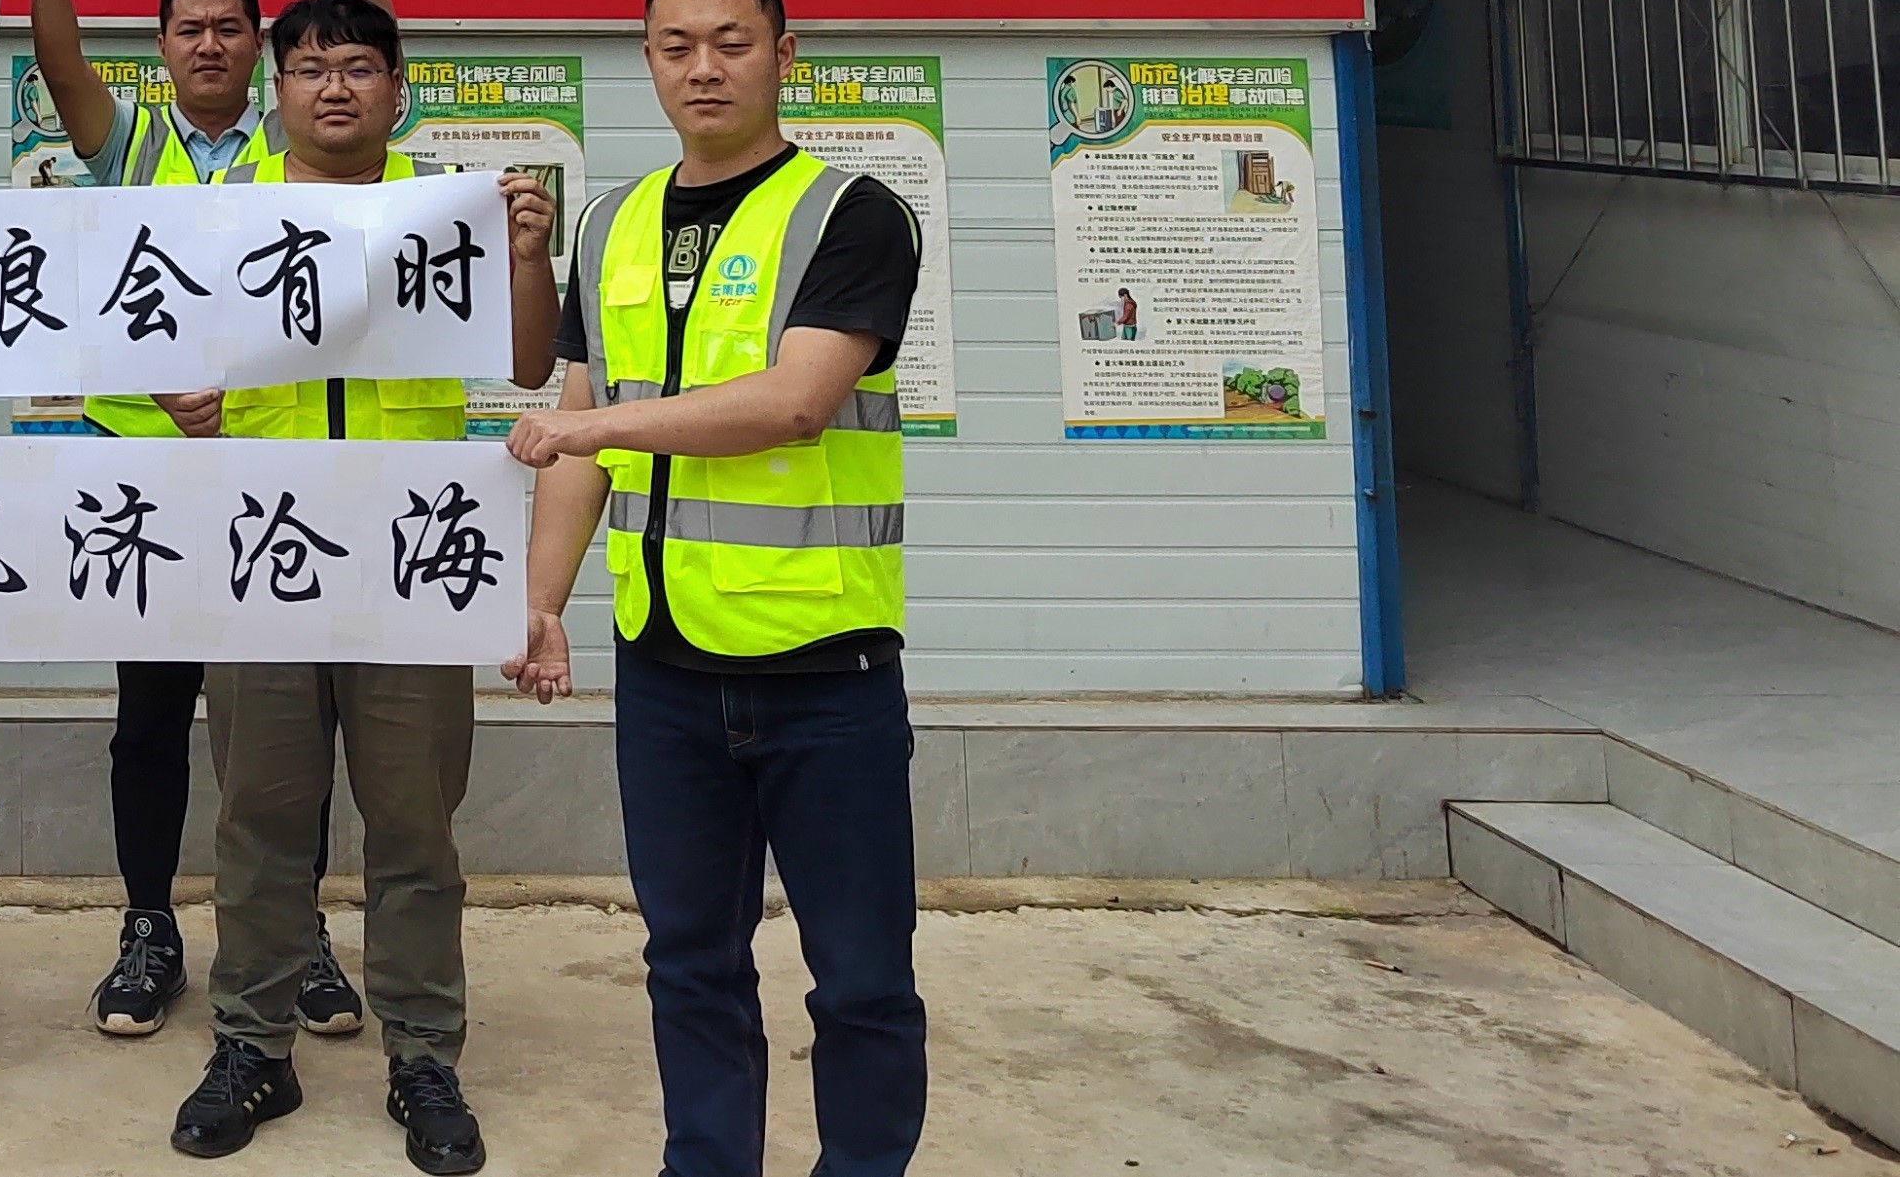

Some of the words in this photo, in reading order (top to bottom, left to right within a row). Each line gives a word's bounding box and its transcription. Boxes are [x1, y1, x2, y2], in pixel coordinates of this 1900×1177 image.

[407, 63, 566, 84] 防范化解安全风险
[1129, 62, 1292, 85] 防范化解安全风险
[419, 82, 578, 104] 排查治理事故隐患
[1141, 84, 1305, 106] 排查治理事故隐患
[431, 131, 541, 141] 安全风险分级与管控措施
[794, 131, 895, 140] 安全生产事故隐患排查
[1161, 133, 1264, 143] 安全生产事故隐患治理
[710, 283, 758, 297] 云南建投
